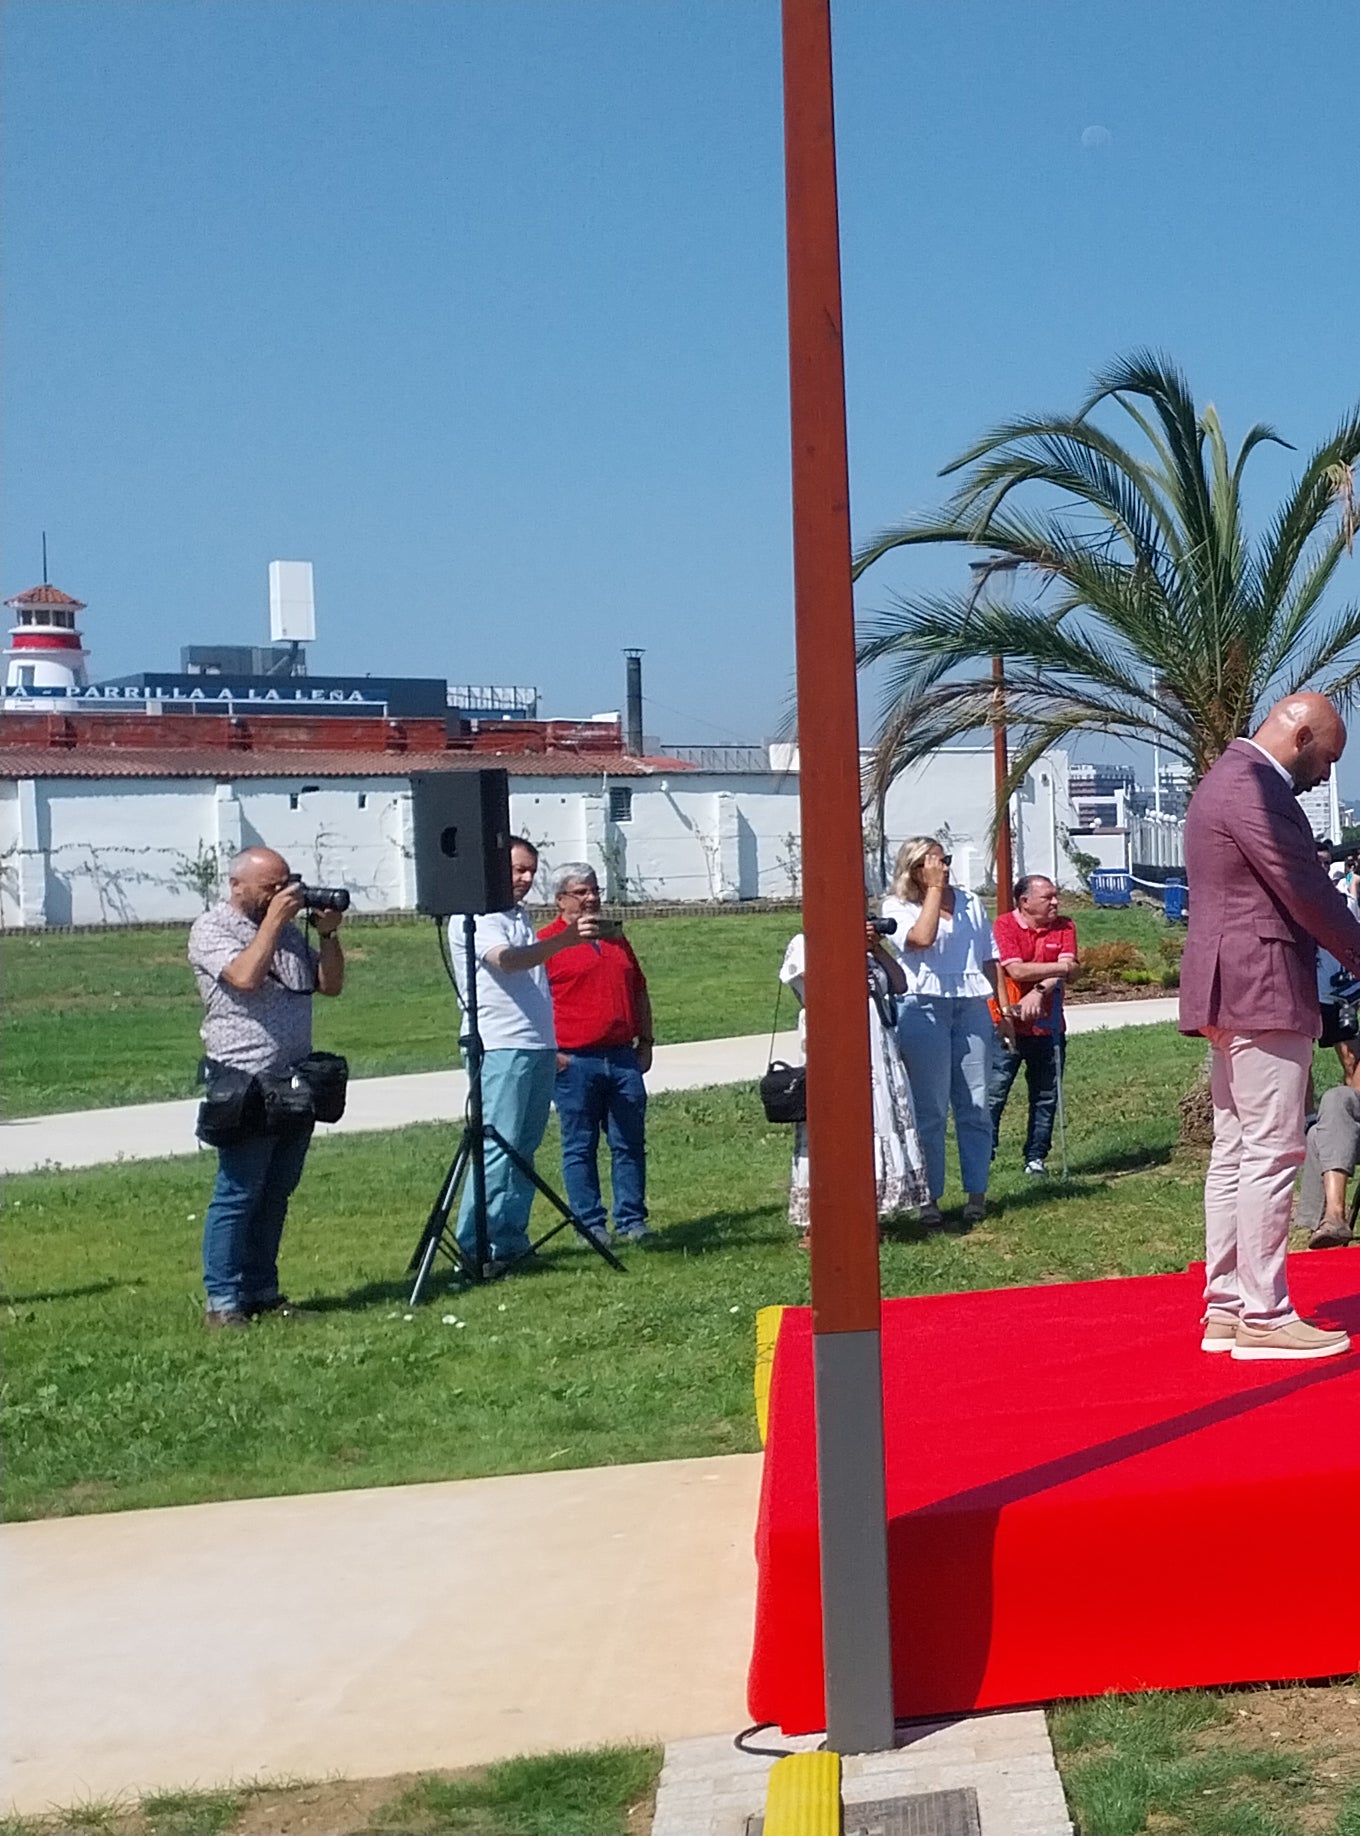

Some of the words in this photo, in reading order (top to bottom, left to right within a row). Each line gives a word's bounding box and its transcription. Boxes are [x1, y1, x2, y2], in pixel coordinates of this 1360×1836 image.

[66, 686, 205, 699] PARRILLA
[218, 687, 233, 699] A
[249, 688, 280, 700] LA
[295, 689, 364, 701] LEÑA
